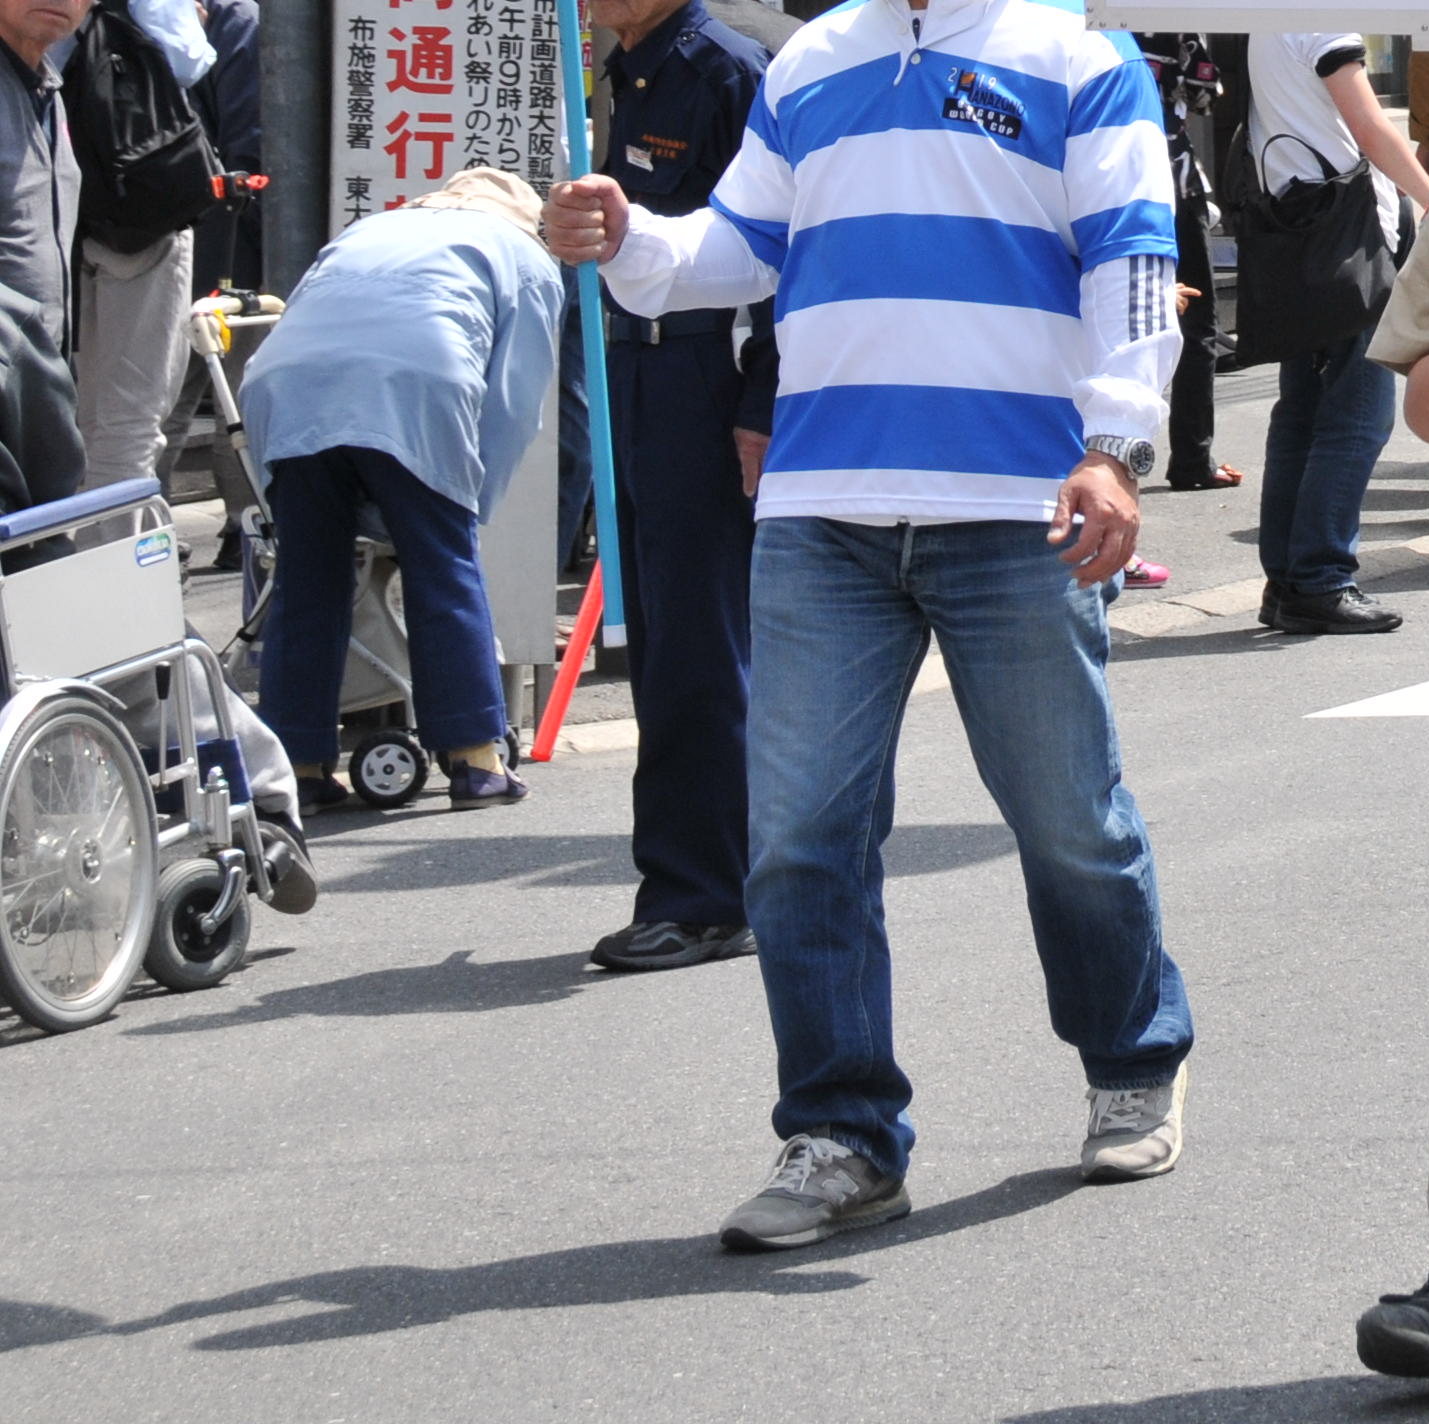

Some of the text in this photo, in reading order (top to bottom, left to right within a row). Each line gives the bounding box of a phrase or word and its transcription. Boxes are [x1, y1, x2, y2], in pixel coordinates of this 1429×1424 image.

[347, 16, 376, 150] 布施警察署
[990, 121, 1014, 136] CUP
